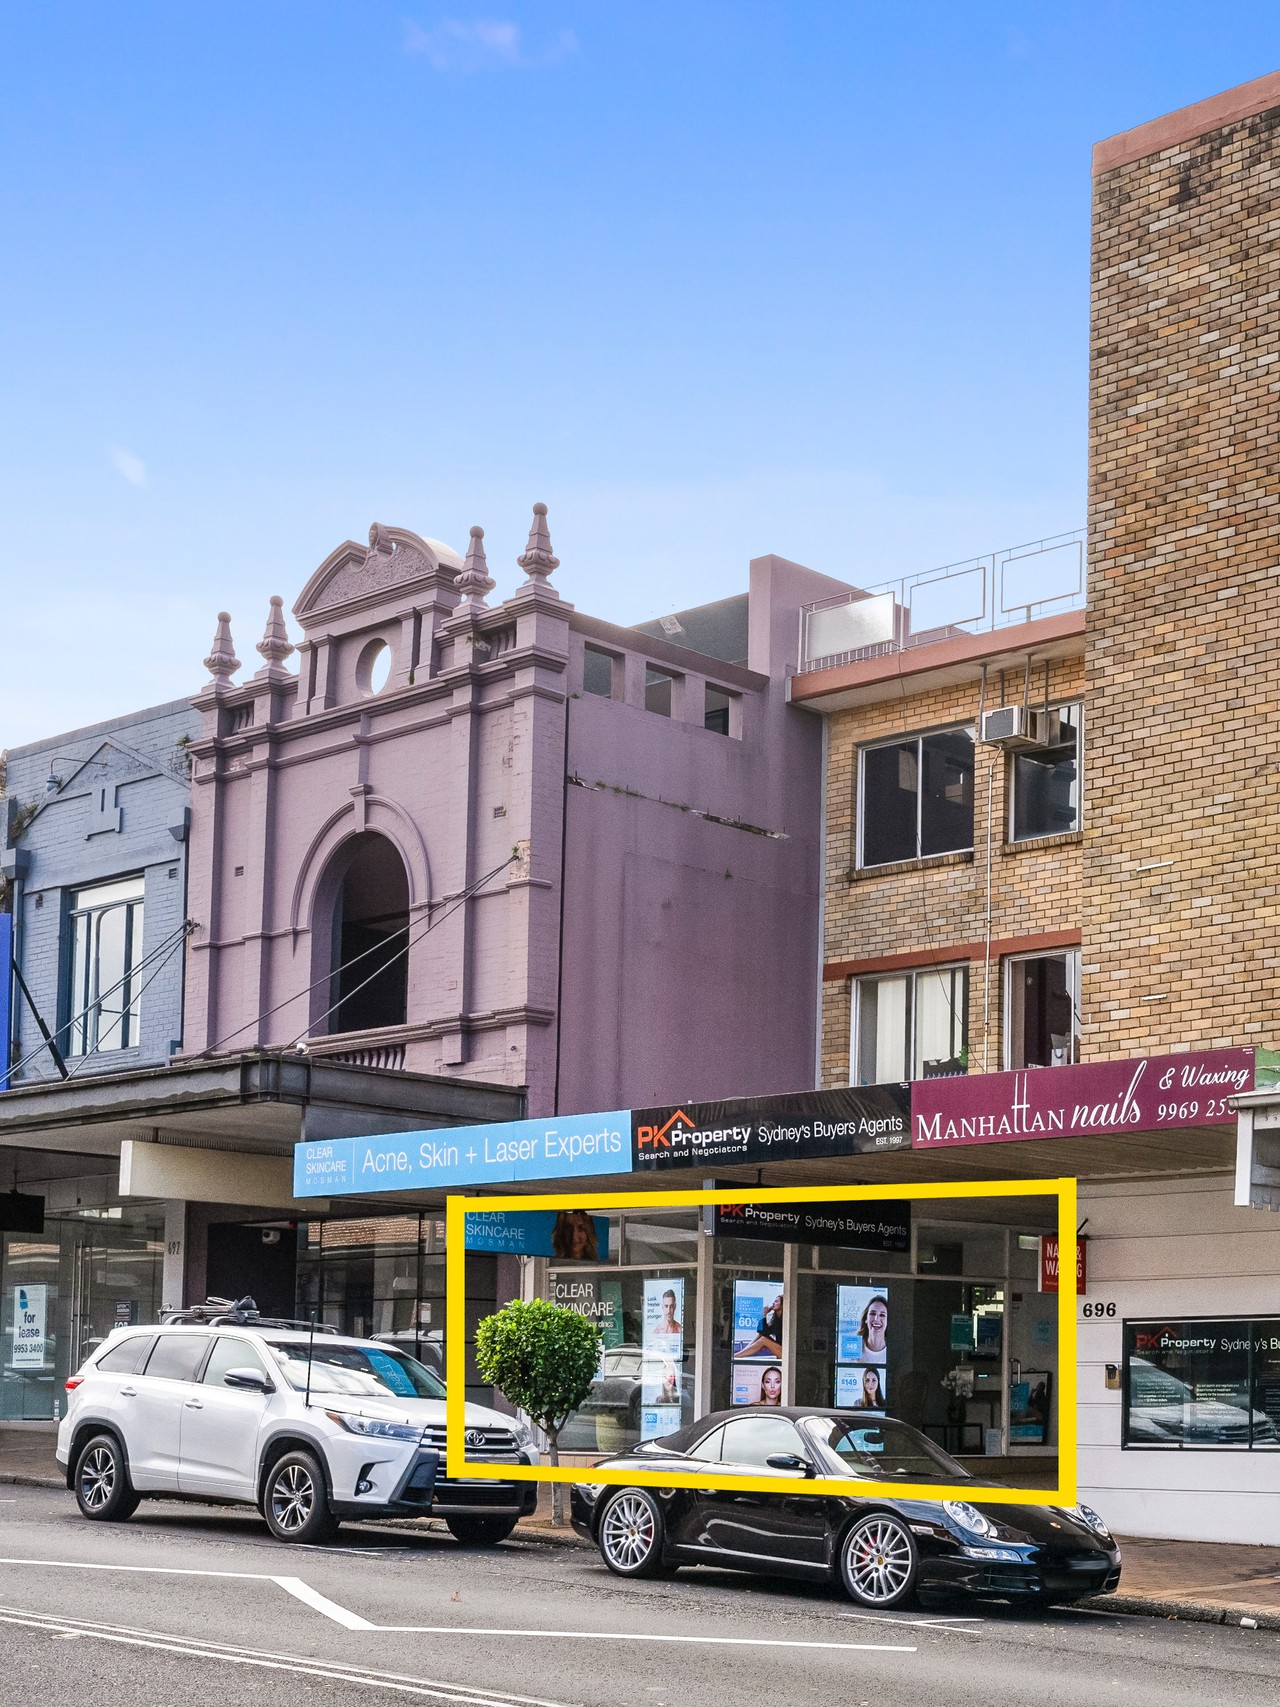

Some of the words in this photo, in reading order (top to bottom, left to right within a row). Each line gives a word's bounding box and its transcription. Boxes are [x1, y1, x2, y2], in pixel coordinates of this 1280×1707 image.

[1159, 1067, 1175, 1090] &
[1180, 1064, 1251, 1090] Waxing
[1070, 1060, 1148, 1129] nails
[1156, 1101, 1199, 1122] 9969
[671, 1126, 751, 1148] Property
[758, 1125, 811, 1145] Sydney's
[813, 1120, 856, 1140] Buyers
[858, 1115, 903, 1137] Agents
[876, 1138, 888, 1146] EST.
[890, 1136, 903, 1144] 1997
[306, 1146, 333, 1160] CLEAR
[361, 1148, 413, 1174] Acne,
[419, 1141, 459, 1169] Skin
[484, 1137, 539, 1163] Laser
[545, 1127, 622, 1162] Experts
[638, 1151, 670, 1161] Search
[673, 1148, 689, 1158] and
[691, 1145, 748, 1157] Negotiators
[306, 1160, 347, 1175] SKINCARE
[305, 1176, 347, 1185] MOSMAN
[466, 1212, 506, 1224] CLEAR
[745, 1208, 800, 1224] Property
[804, 1216, 845, 1231] Sydney's
[846, 1219, 876, 1234] Buyers
[878, 1222, 907, 1237] Agents
[466, 1224, 526, 1240] SKINCARE
[466, 1236, 526, 1249] MOSMAN
[556, 1283, 594, 1298] CLEAR
[1082, 1302, 1117, 1318] 696
[24, 1312, 36, 1324] for
[18, 1326, 40, 1339] lease
[14, 1344, 28, 1354] 9953
[29, 1343, 44, 1354] 3400
[1160, 1337, 1217, 1349] Property
